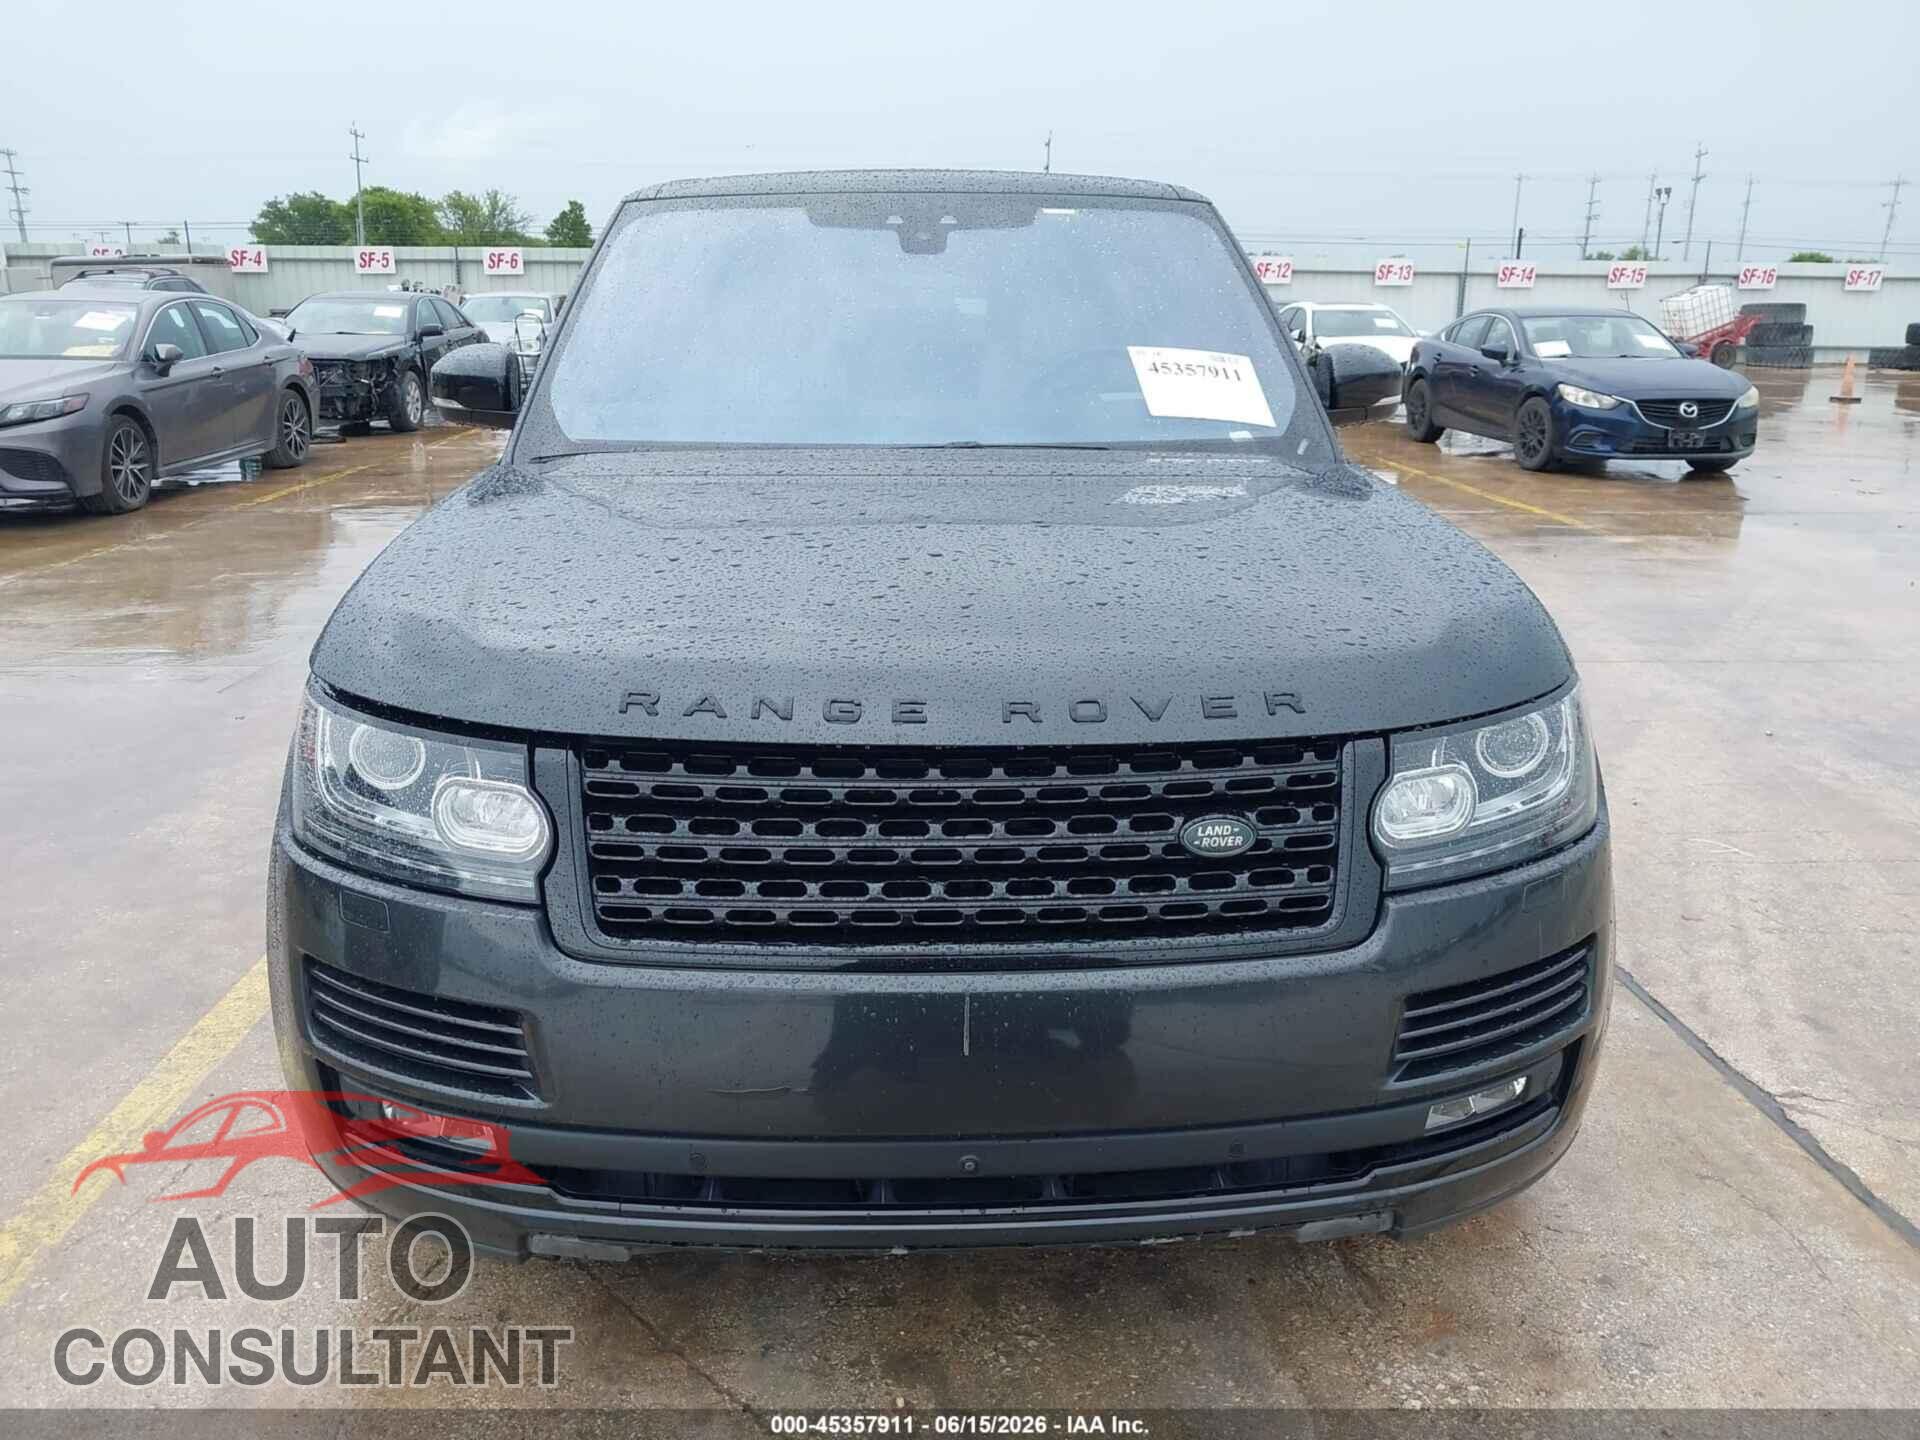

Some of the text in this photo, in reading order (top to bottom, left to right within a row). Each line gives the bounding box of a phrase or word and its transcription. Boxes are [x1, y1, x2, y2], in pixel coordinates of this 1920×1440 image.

[231, 249, 262, 267] SF-4
[359, 251, 390, 269] SF-5
[488, 252, 519, 270] SF-6
[1256, 262, 1291, 279] SF-12
[1377, 264, 1412, 281] SF-13
[1500, 266, 1535, 283] SF-14
[1609, 267, 1645, 284] SF-15
[1740, 268, 1776, 285] SF-16
[1847, 270, 1881, 287] SF-17
[1148, 361, 1242, 383] 45357911
[618, 691, 1306, 724] RANGE ROVER
